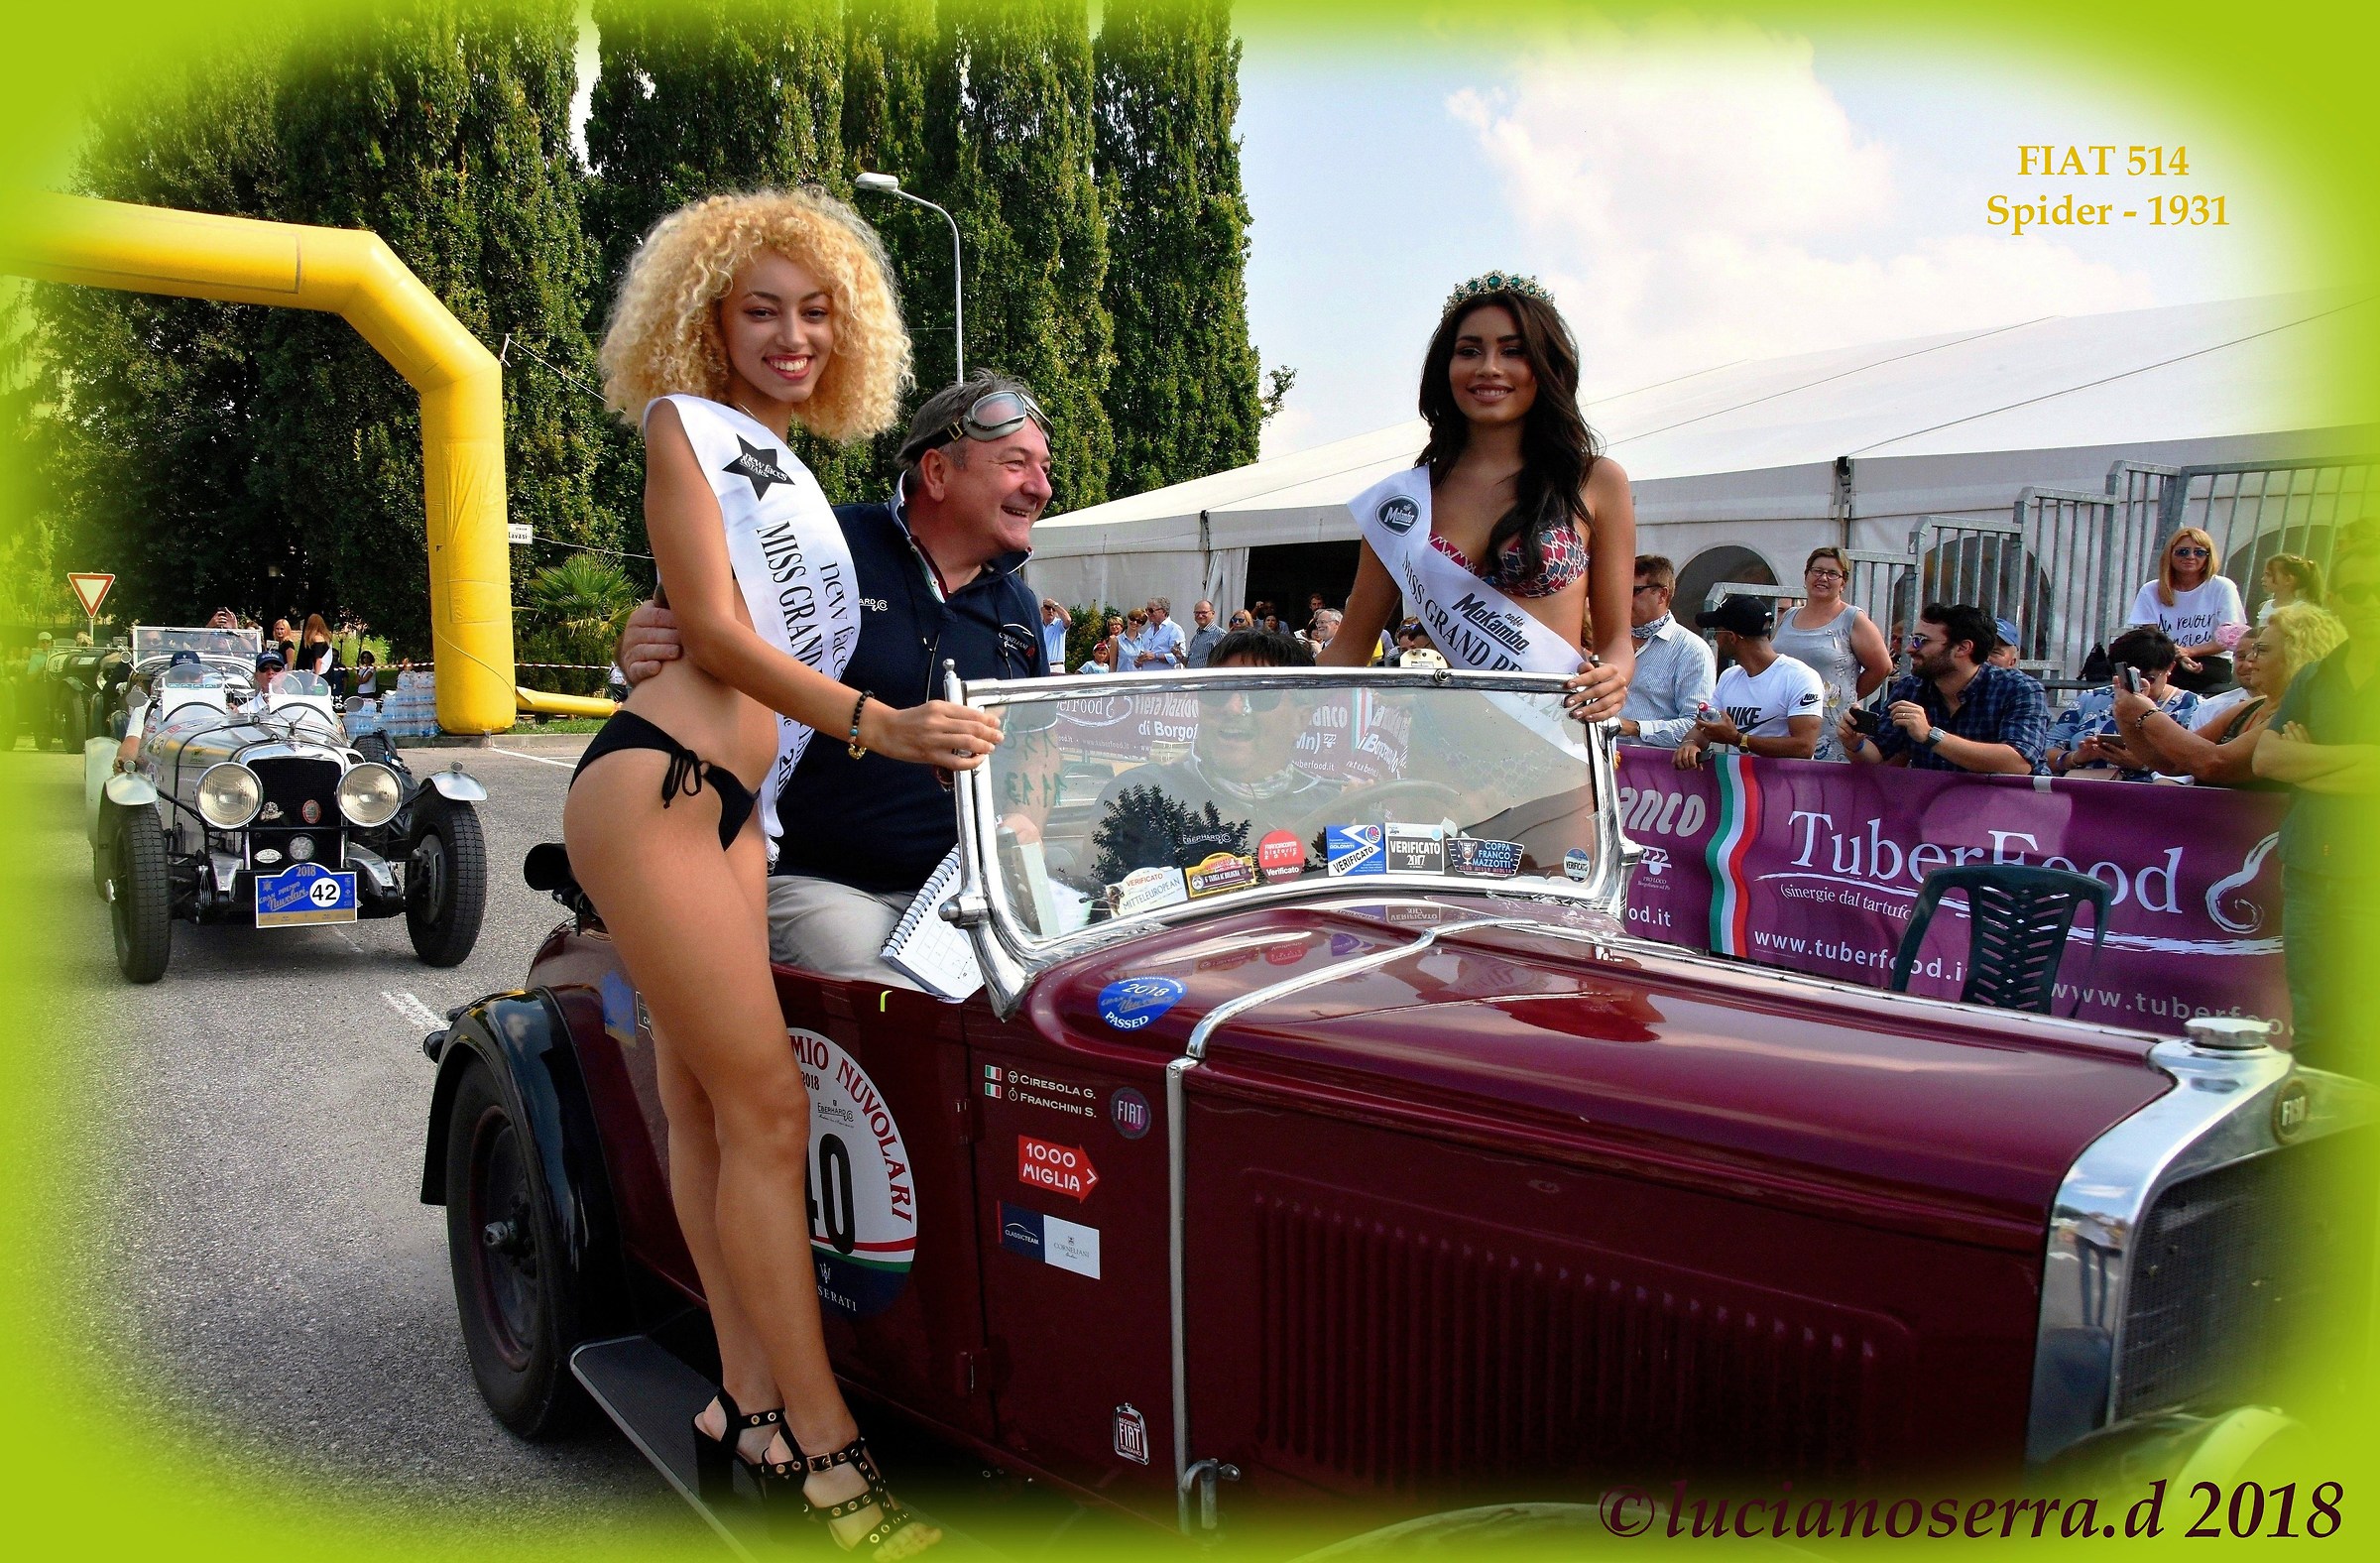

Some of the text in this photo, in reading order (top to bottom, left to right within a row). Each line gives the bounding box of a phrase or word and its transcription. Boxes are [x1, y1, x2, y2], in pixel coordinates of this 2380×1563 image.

[756, 521, 807, 583] MISS
[819, 560, 849, 621] new
[1402, 549, 1425, 605] MISS
[1424, 599, 1490, 666] GRAND
[2177, 614, 2215, 631] revoir
[1803, 692, 1819, 701] NIKE
[1308, 705, 1348, 729] anco
[1726, 706, 1762, 726] NIKE
[1137, 720, 1151, 735] di
[1390, 840, 1441, 855] VERIFICATO
[1478, 850, 1511, 860] FRANCO
[1485, 842, 1511, 852] COPPA
[1332, 846, 1374, 874] VERIFICATO
[1406, 855, 1426, 866] 2017
[1472, 857, 1511, 869] MAZZOTTI
[296, 866, 316, 877] 2018
[1126, 873, 1163, 887] VERIFICATO
[1266, 866, 1300, 877] Verificato
[311, 884, 337, 902] 42
[1122, 877, 1181, 910] MITTELEUROPEAN
[1780, 883, 1836, 903] (sinergie
[1839, 890, 1859, 907] dal
[1122, 983, 1170, 997] 2018
[1105, 1011, 1149, 1029] PASSED
[1020, 1075, 1097, 1100] CIRESOLA G.
[1020, 1093, 1097, 1119] FRANCHINI S.
[1118, 1100, 1143, 1125] FIAT
[835, 1056, 912, 1224] NUVOLARI
[1025, 1142, 1076, 1168] 1000
[1022, 1162, 1081, 1192] MIGLIA
[1005, 1229, 1039, 1246] CLASSICTEAM
[1053, 1242, 1090, 1259] CORNELIANI
[816, 1284, 857, 1312] SERATI
[1119, 1422, 1140, 1451] FIAT
